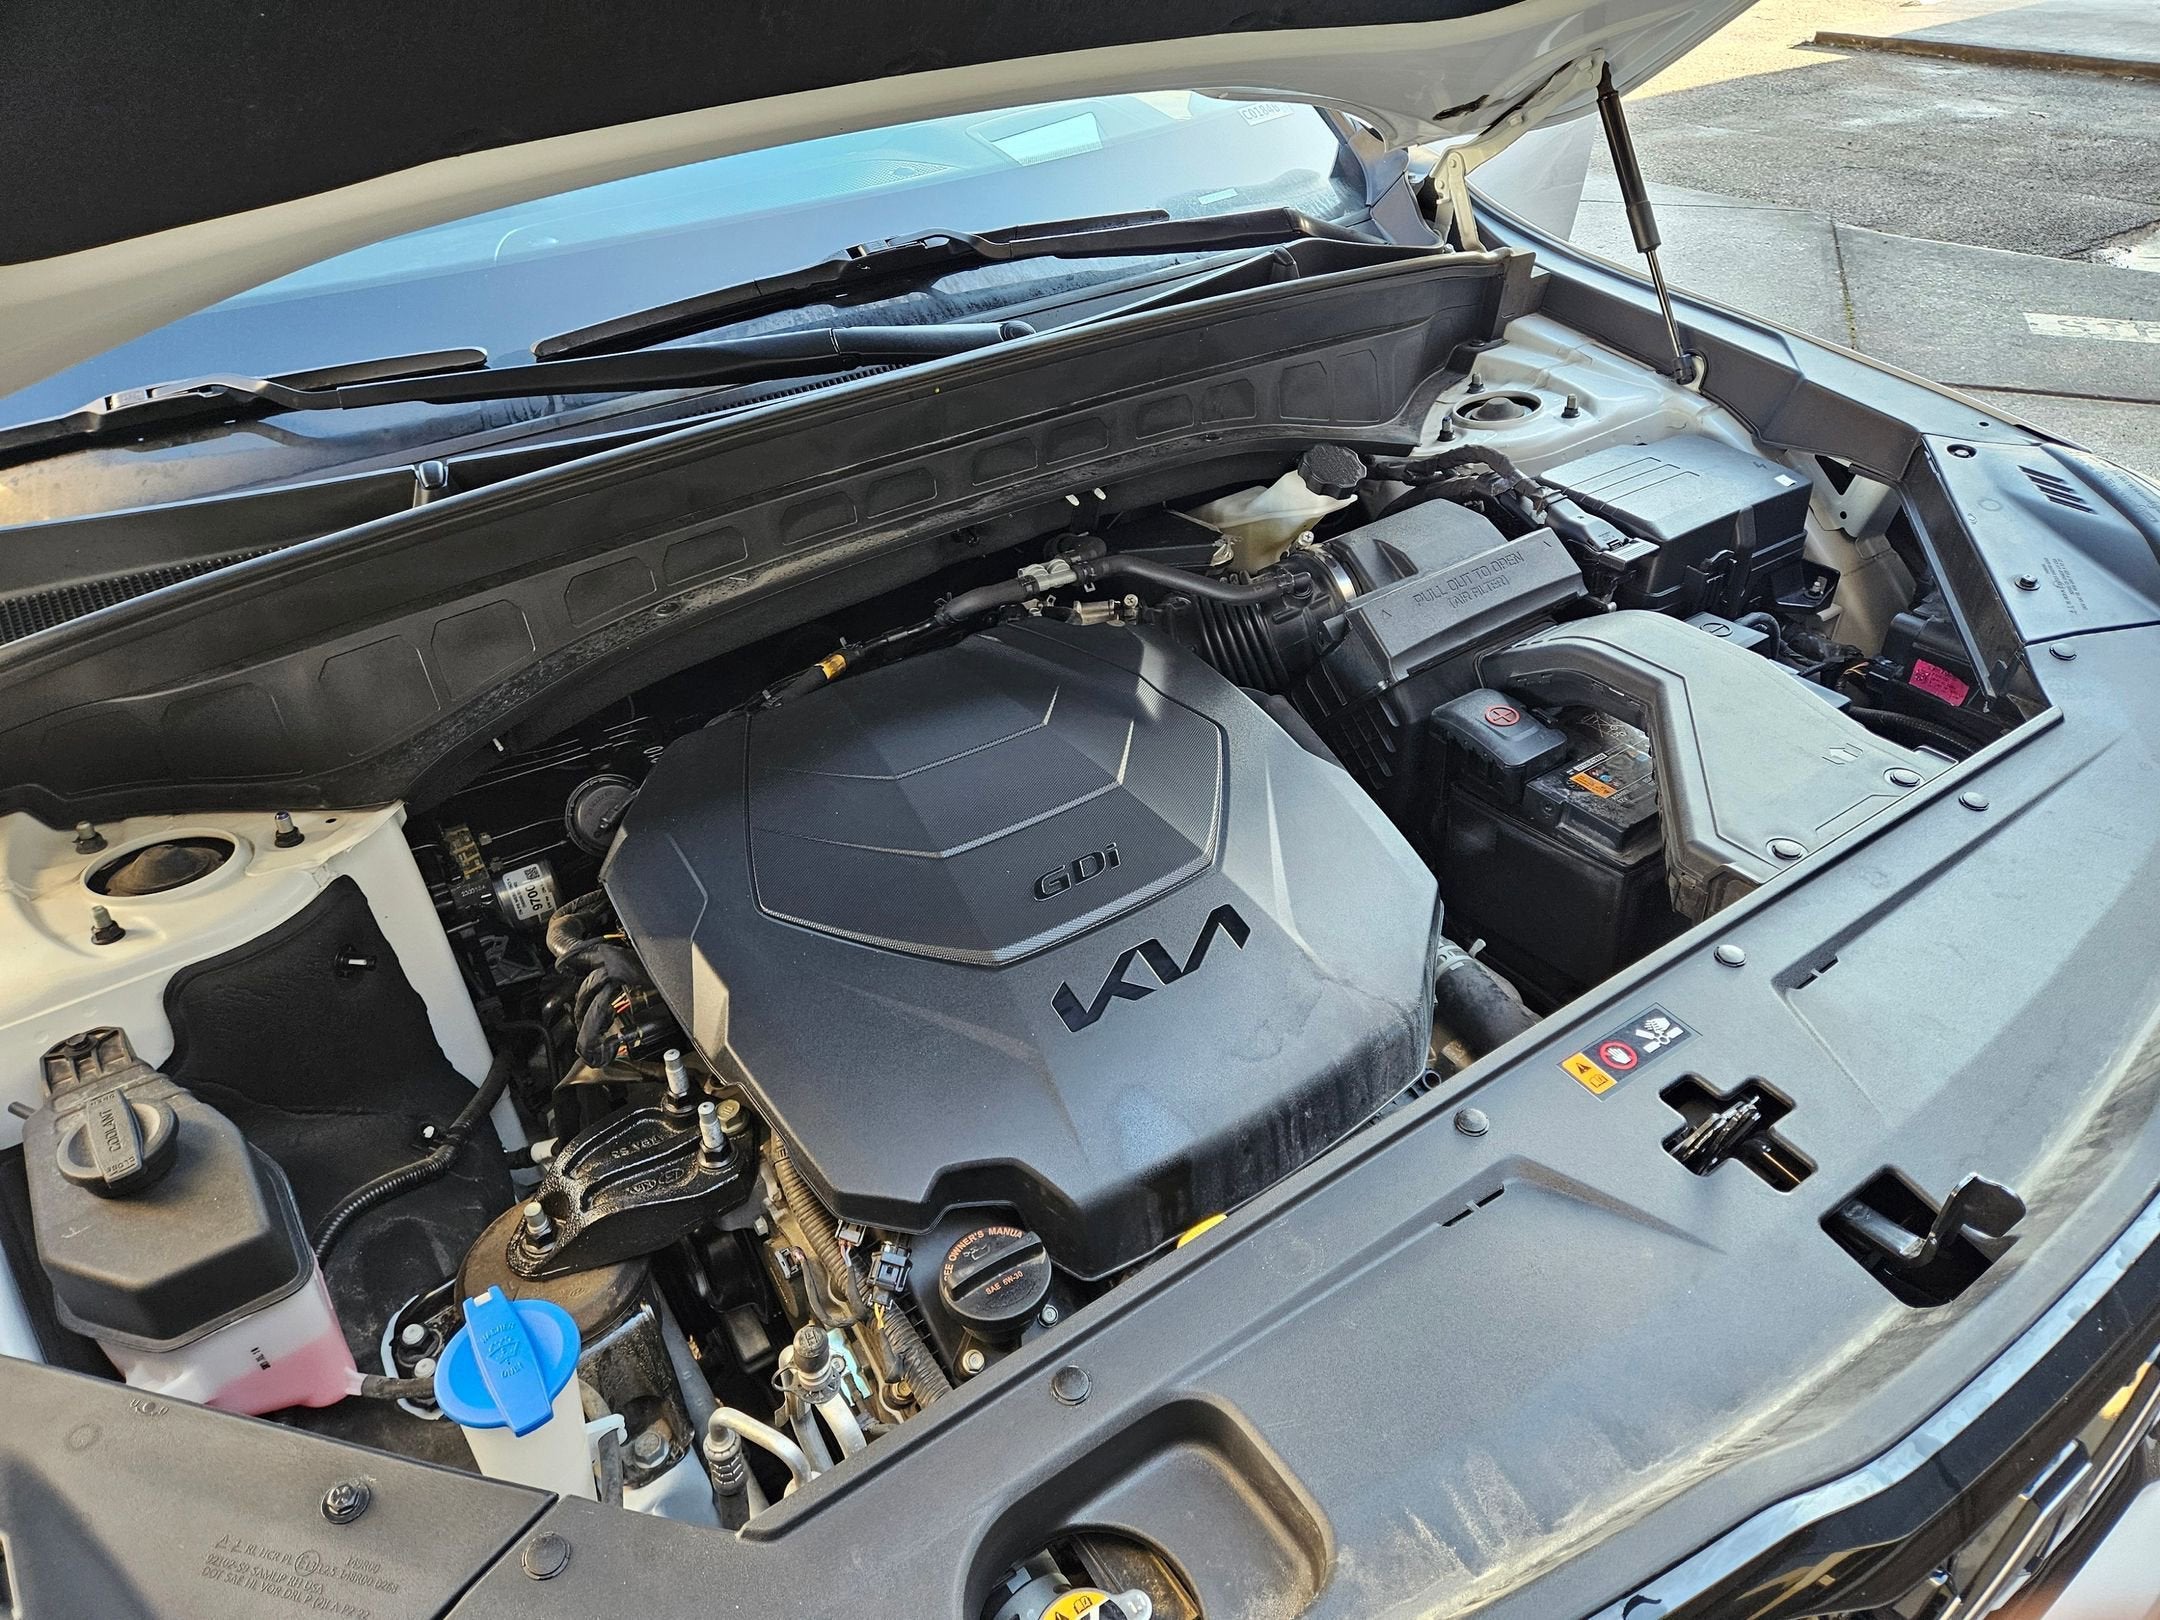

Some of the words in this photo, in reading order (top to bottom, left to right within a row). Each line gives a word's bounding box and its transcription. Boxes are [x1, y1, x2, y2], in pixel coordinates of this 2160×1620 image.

[1413, 584, 1448, 607] PULL
[1446, 572, 1474, 592] OUT
[1471, 565, 1492, 580] TO
[1489, 551, 1525, 573] OPEN
[1033, 842, 1121, 902] GDi
[1051, 903, 1251, 1033] KIA
[99, 1108, 122, 1153] COOLANT
[948, 1230, 985, 1262] OWNER'S
[988, 1226, 1024, 1239] MANUA
[985, 1282, 1002, 1295] SAE
[303, 1580, 325, 1594] USA
